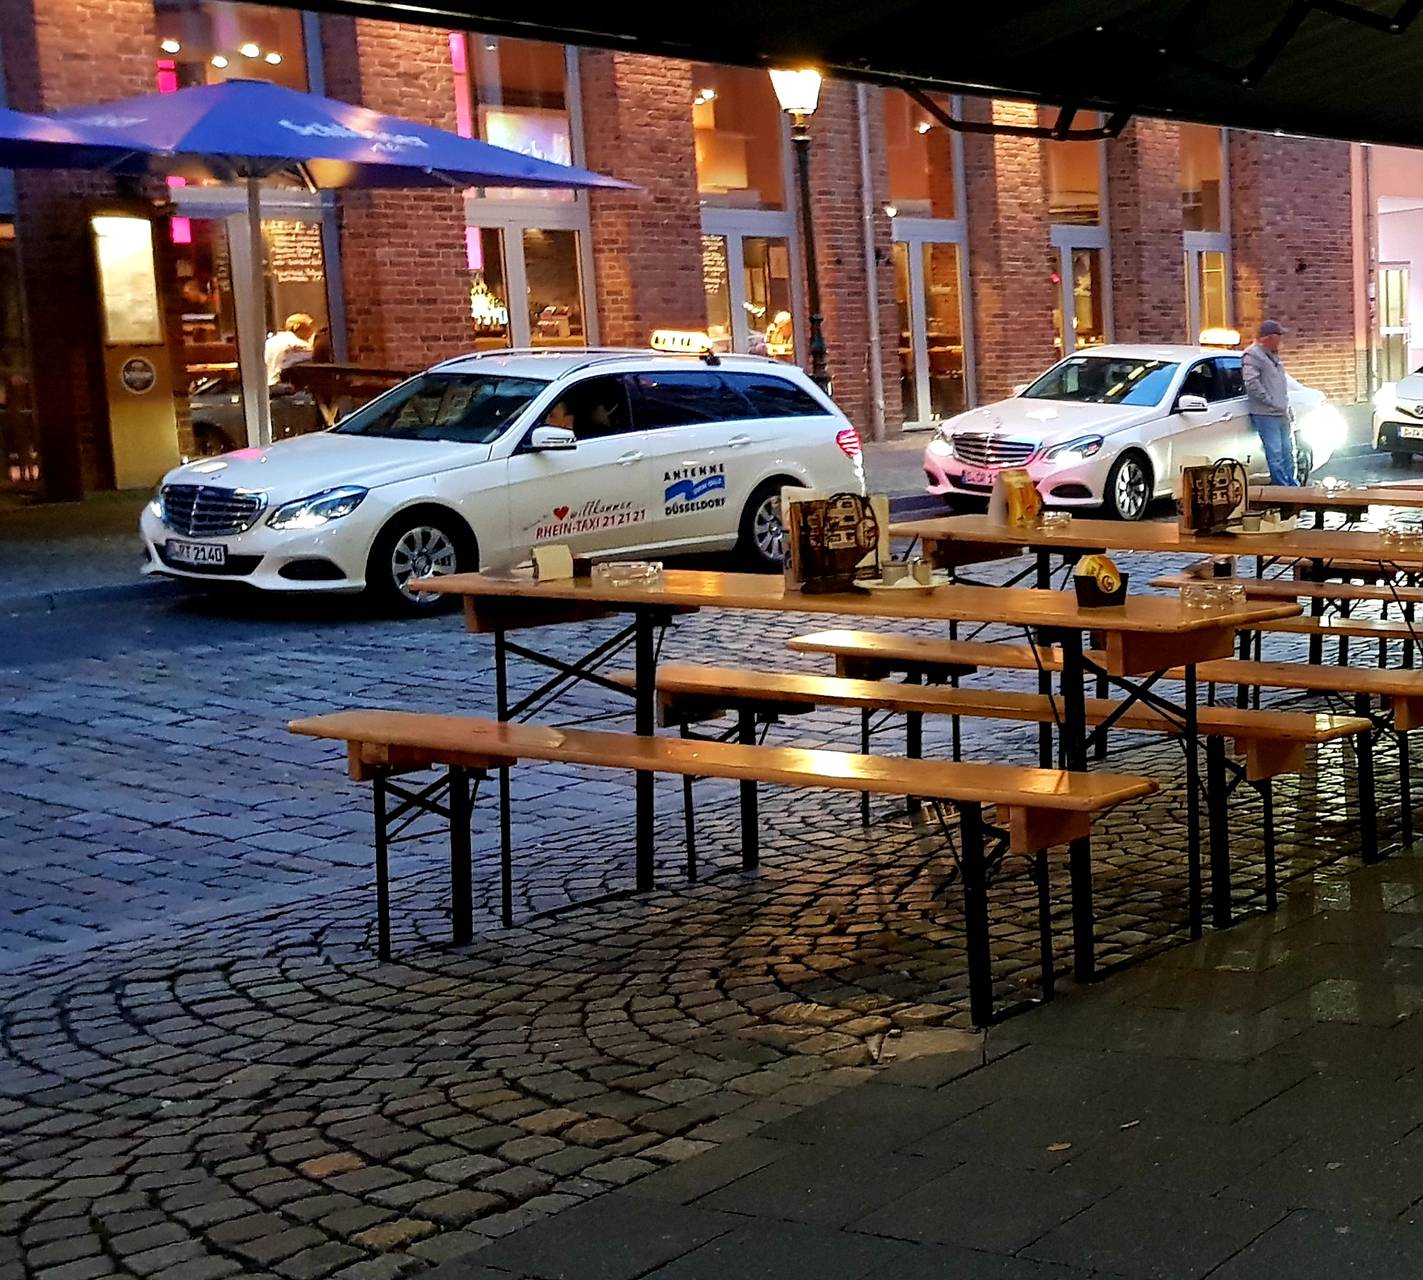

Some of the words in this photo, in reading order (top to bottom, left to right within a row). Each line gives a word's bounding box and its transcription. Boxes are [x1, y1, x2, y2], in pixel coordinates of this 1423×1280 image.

[663, 463, 724, 481] ANTENNE
[664, 498, 726, 516] DÜSSELDORF
[535, 519, 600, 540] RHEIN-TAXI
[193, 546, 224, 562] 2140
